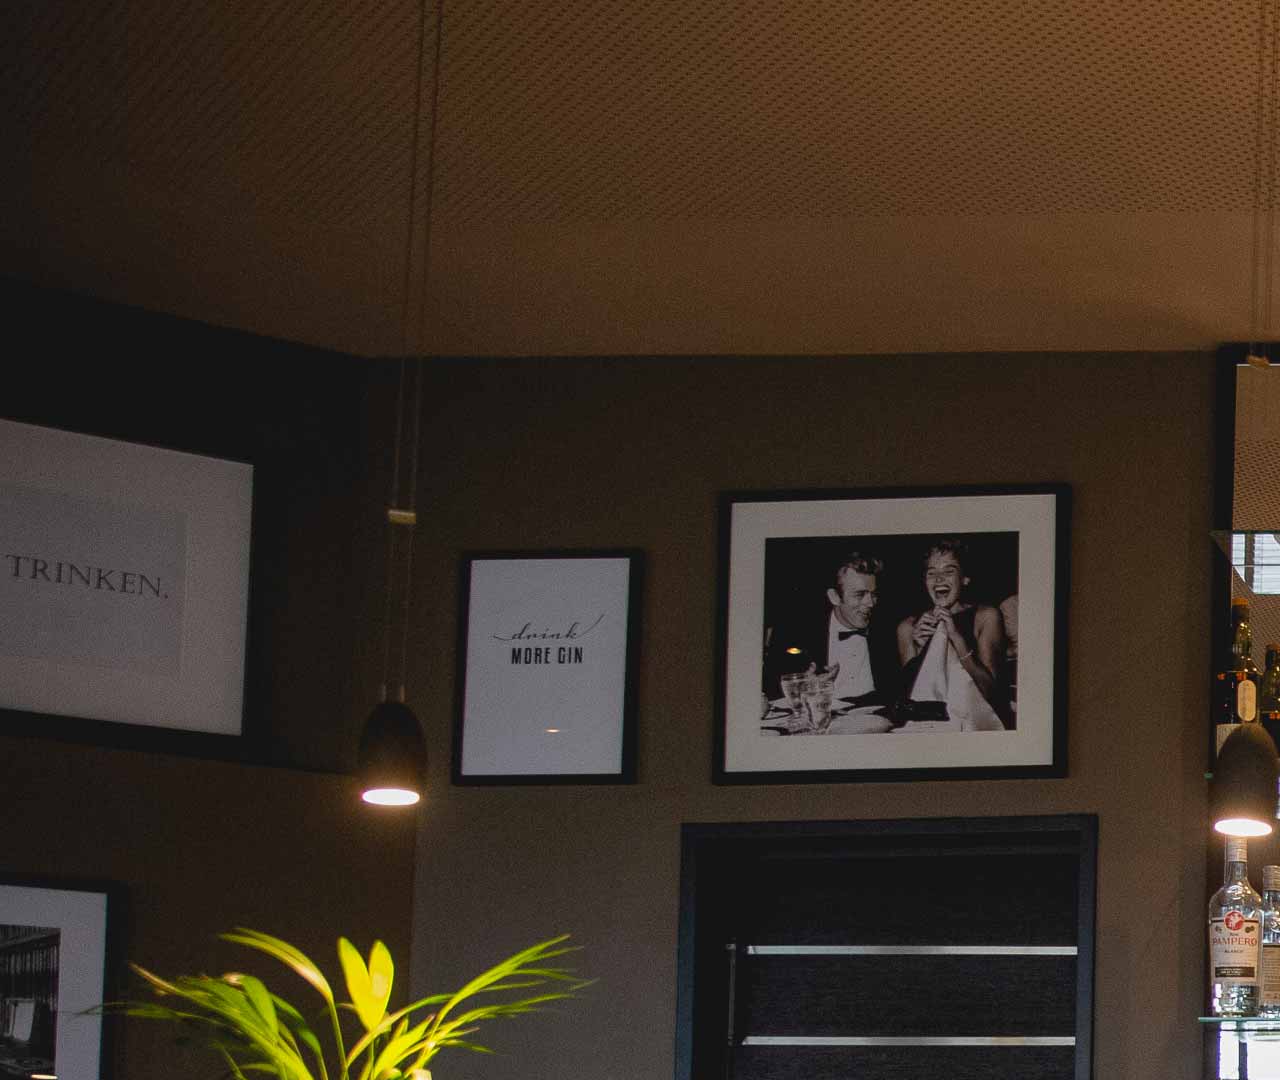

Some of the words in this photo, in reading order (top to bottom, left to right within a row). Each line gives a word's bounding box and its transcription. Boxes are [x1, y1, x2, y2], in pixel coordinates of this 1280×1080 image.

[5, 554, 169, 599] TRINKEN.
[491, 613, 604, 641] drink
[511, 647, 551, 664] MORE
[558, 646, 583, 664] GIN
[1213, 937, 1257, 946] PAMPERO
